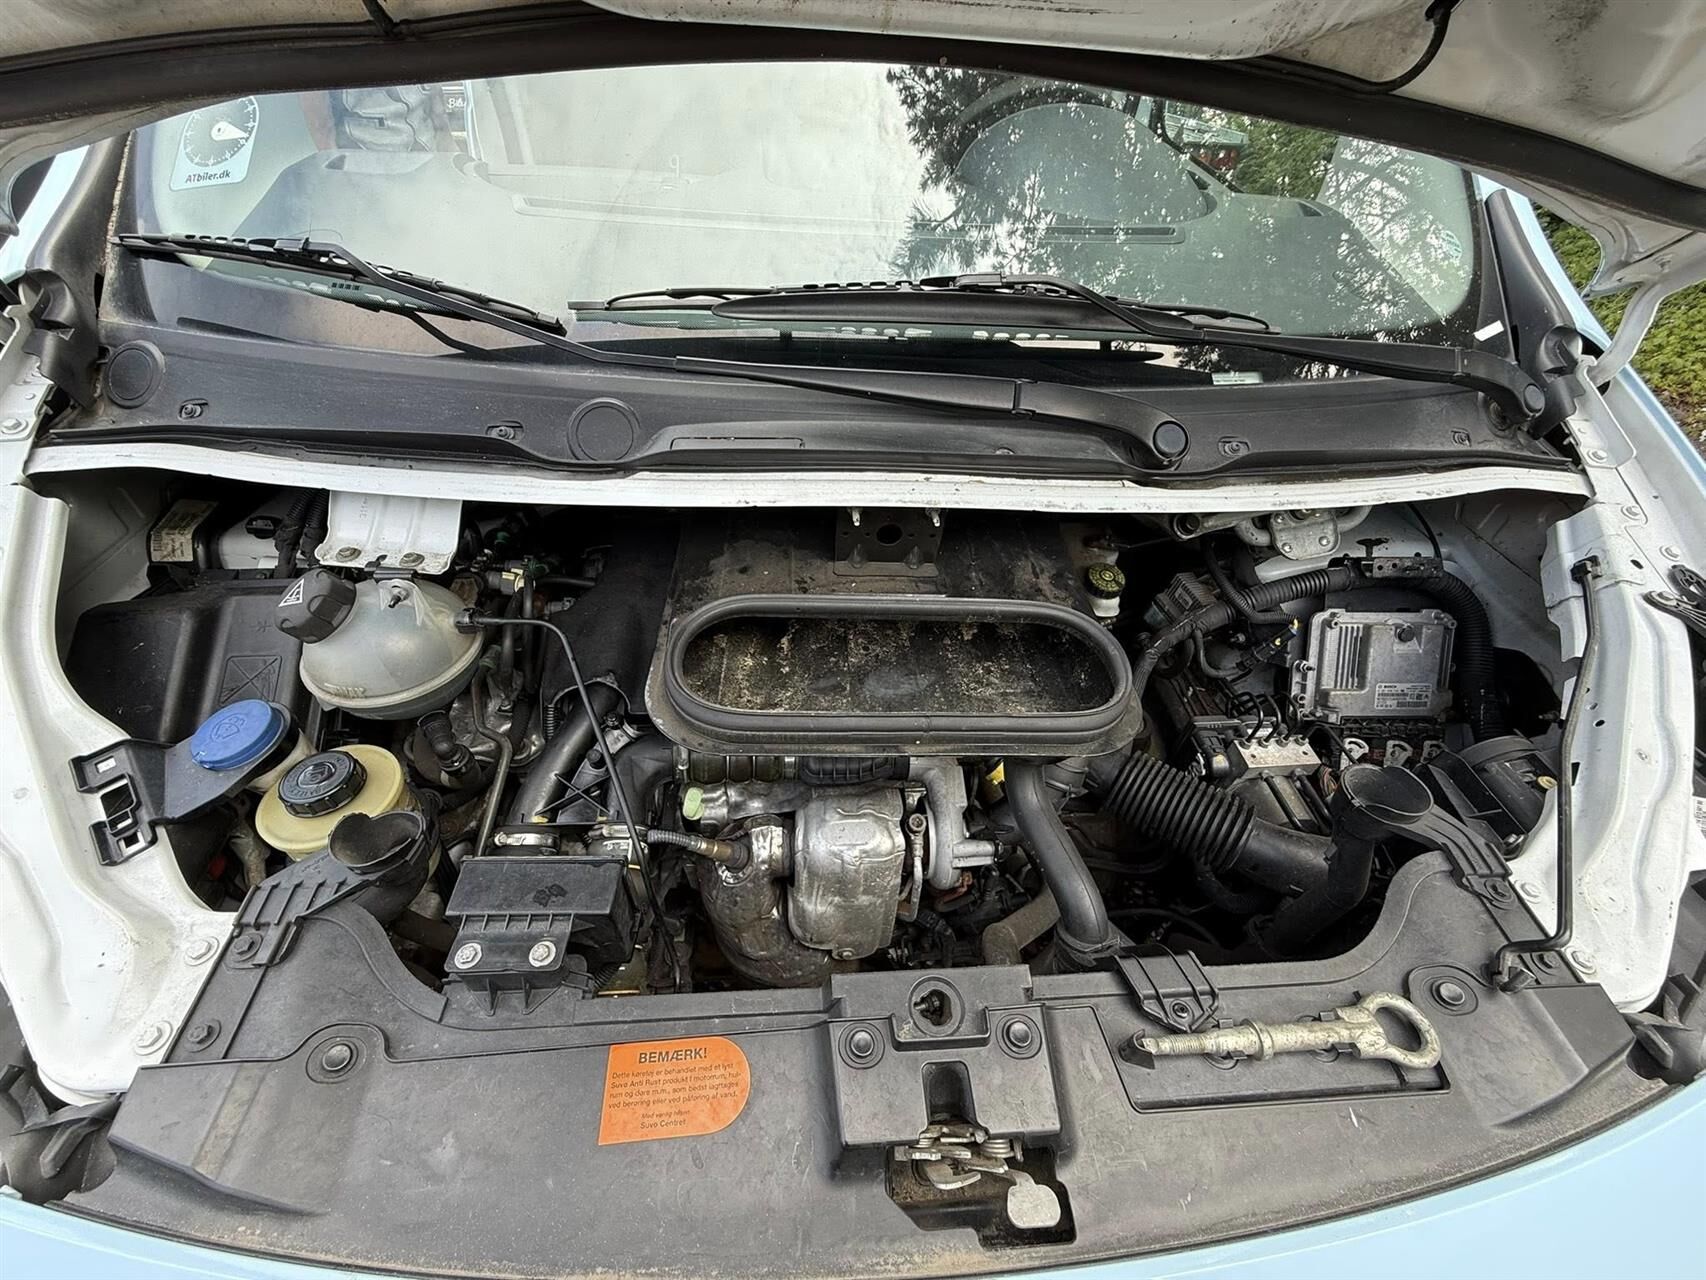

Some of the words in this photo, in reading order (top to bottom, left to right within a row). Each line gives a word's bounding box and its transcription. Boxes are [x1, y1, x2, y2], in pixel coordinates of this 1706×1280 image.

[185, 170, 231, 183] ATbiler.dk
[639, 1047, 707, 1064] BEMÆRK!
[664, 1067, 696, 1076] behandlet
[698, 1064, 712, 1072] med
[611, 1081, 628, 1089] Suvo
[645, 1078, 660, 1086] Rust
[662, 1076, 688, 1085] produkt
[624, 1091, 633, 1099] og
[672, 1086, 687, 1094] som
[688, 1084, 707, 1092] bedst
[608, 1100, 621, 1109] ved
[652, 1097, 667, 1105] eller
[668, 1095, 681, 1104] ved
[720, 1090, 738, 1099] vand.
[640, 1121, 658, 1129] Suvo
[659, 1119, 687, 1128] Centret
